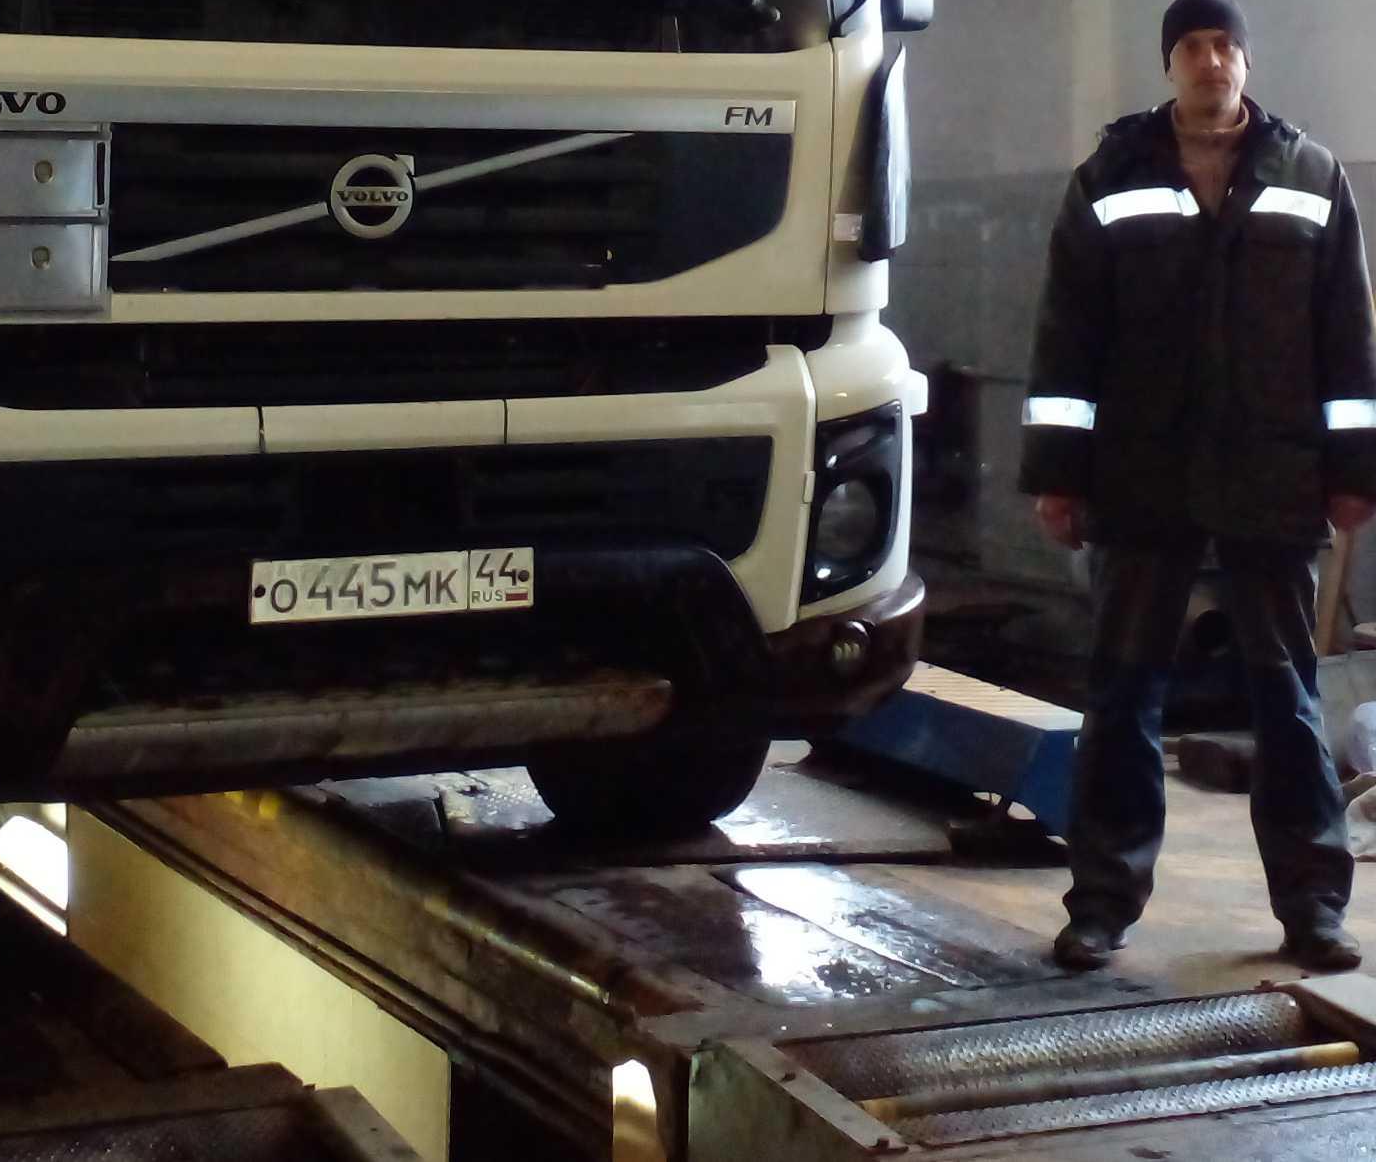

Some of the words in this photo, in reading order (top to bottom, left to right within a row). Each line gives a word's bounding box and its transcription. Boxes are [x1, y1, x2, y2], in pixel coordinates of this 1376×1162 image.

[724, 106, 773, 126] FM
[335, 190, 409, 202] VOLVO
[474, 551, 517, 588] 44
[470, 589, 504, 603] RUS
